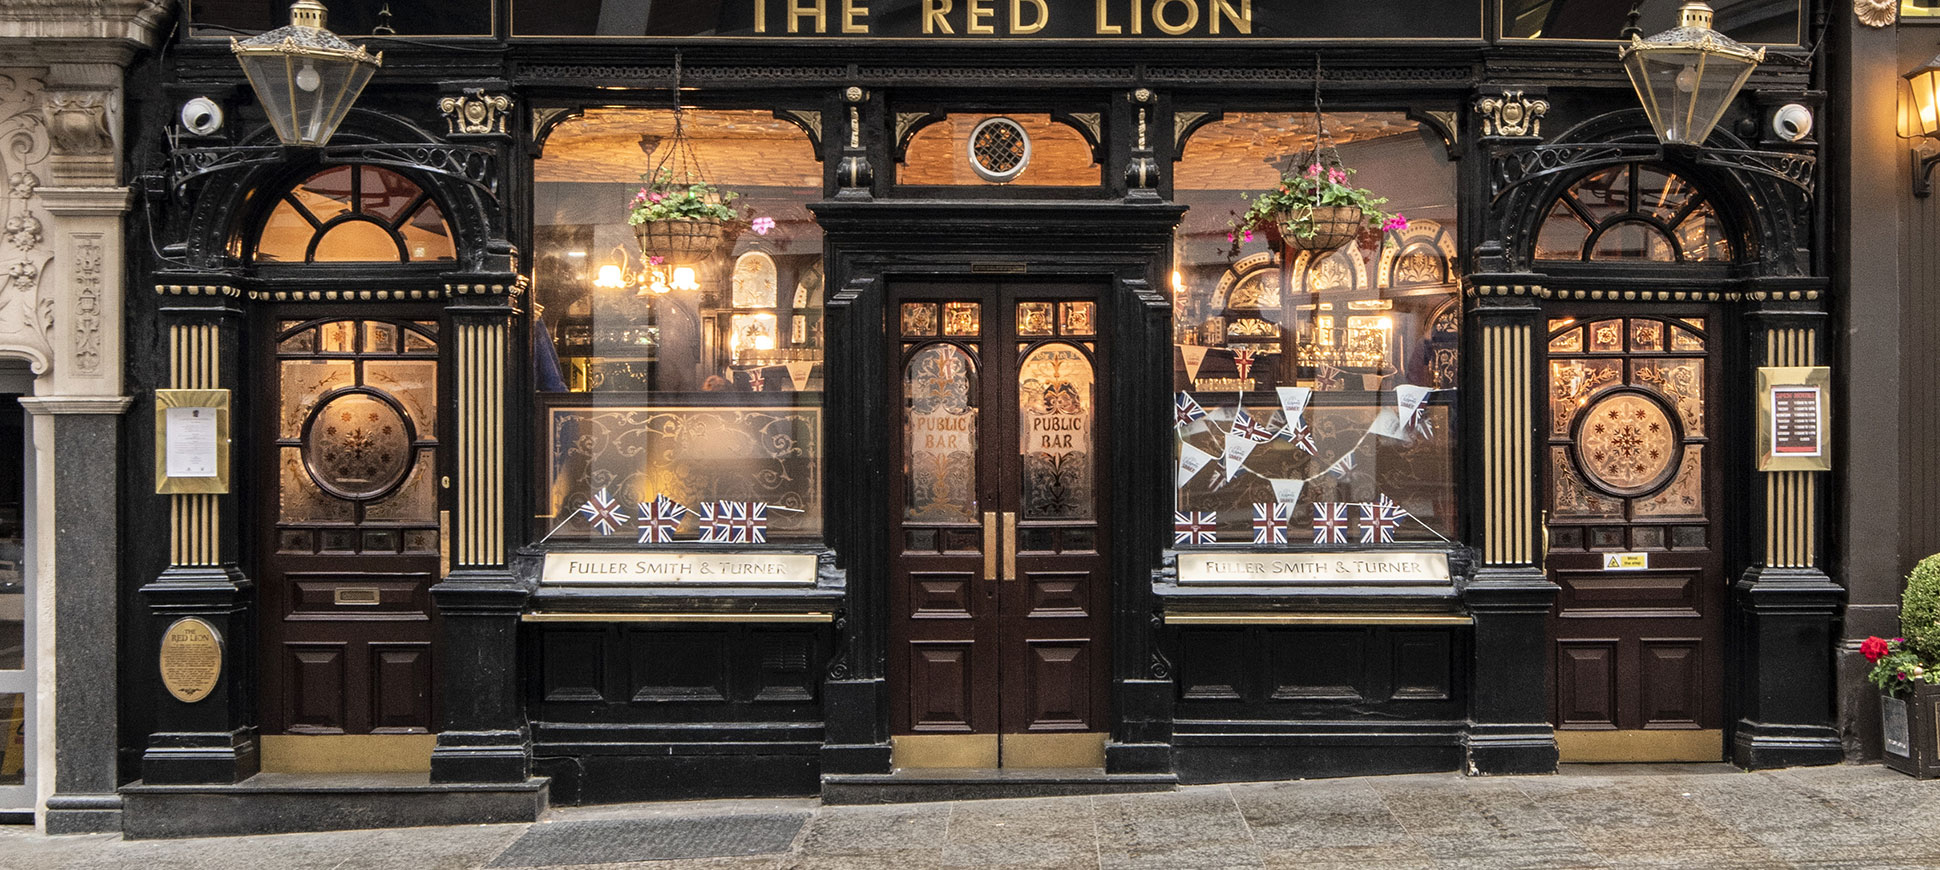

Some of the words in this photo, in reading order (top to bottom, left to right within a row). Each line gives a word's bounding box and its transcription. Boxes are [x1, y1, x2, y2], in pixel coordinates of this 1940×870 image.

[922, 0, 1048, 34] RED
[1095, 0, 1252, 34] LION
[917, 417, 966, 431] PUBLIC
[1033, 417, 1081, 431] PUBLIC
[925, 435, 957, 448] BAR
[1041, 434, 1072, 448] BAR
[700, 562, 714, 574] &
[1335, 562, 1349, 573] &
[171, 634, 188, 642] RED
